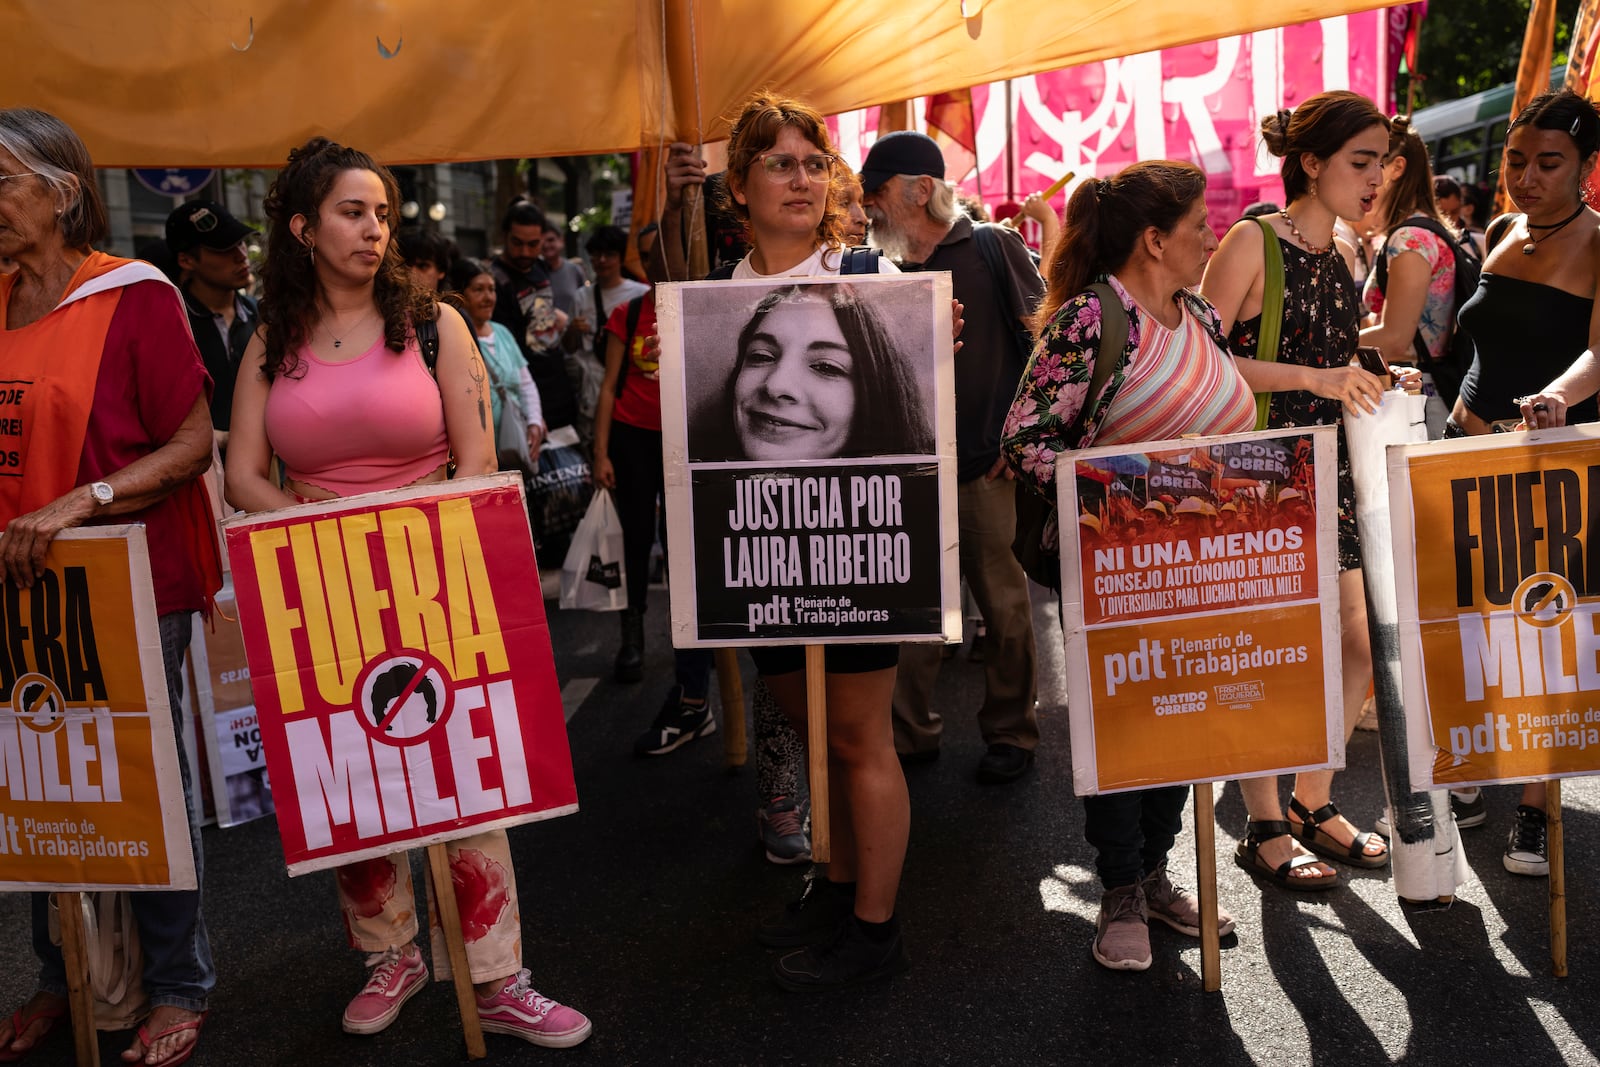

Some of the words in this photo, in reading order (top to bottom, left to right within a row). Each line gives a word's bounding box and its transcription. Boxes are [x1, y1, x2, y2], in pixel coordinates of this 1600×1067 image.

[1241, 442, 1287, 462] POLO
[1229, 456, 1291, 479] OBRERO
[728, 476, 845, 531] JUSTICIA
[850, 475, 903, 528] POR
[723, 535, 804, 588] LAURA
[809, 531, 911, 586] RIBEIRO
[1094, 547, 1125, 572] NI
[1132, 540, 1193, 568] UNA
[1200, 526, 1303, 560] MENOS
[1094, 569, 1163, 595] CONSEJO
[1165, 560, 1246, 587] AUTÓNOMO
[1248, 558, 1260, 577] DE
[1261, 552, 1306, 576] MUJERES
[249, 497, 510, 714] FUERA
[1099, 598, 1107, 616] Y
[1108, 590, 1174, 615] DIVERSIDADES
[1175, 587, 1199, 608] PARA
[1201, 582, 1236, 605] LUCHAR
[1238, 578, 1274, 600] CONTRA
[1276, 575, 1302, 595] MILEI
[748, 594, 791, 632] pdt
[794, 596, 836, 608] Plenario
[838, 596, 851, 607] de
[794, 607, 889, 626] Trabajadoras
[1104, 638, 1166, 696] pdt
[1171, 632, 1231, 654] Plenario
[1235, 631, 1253, 647] de
[1172, 645, 1308, 677] Trabajadoras
[1152, 691, 1208, 706] PARTIDO
[1218, 684, 1248, 694] FRENTE
[1219, 688, 1261, 701] IZQUIERDA
[1155, 702, 1206, 716] OBRERO
[1450, 712, 1512, 766] pdt
[1517, 709, 1580, 729] Plenario
[1584, 707, 1600, 723] de
[1518, 724, 1600, 750] Trabaja
[245, 744, 264, 762] A
[284, 679, 533, 851] MILEI
[24, 818, 77, 834] Plenario
[81, 819, 96, 834] de
[26, 834, 149, 861] Trabajadoras
